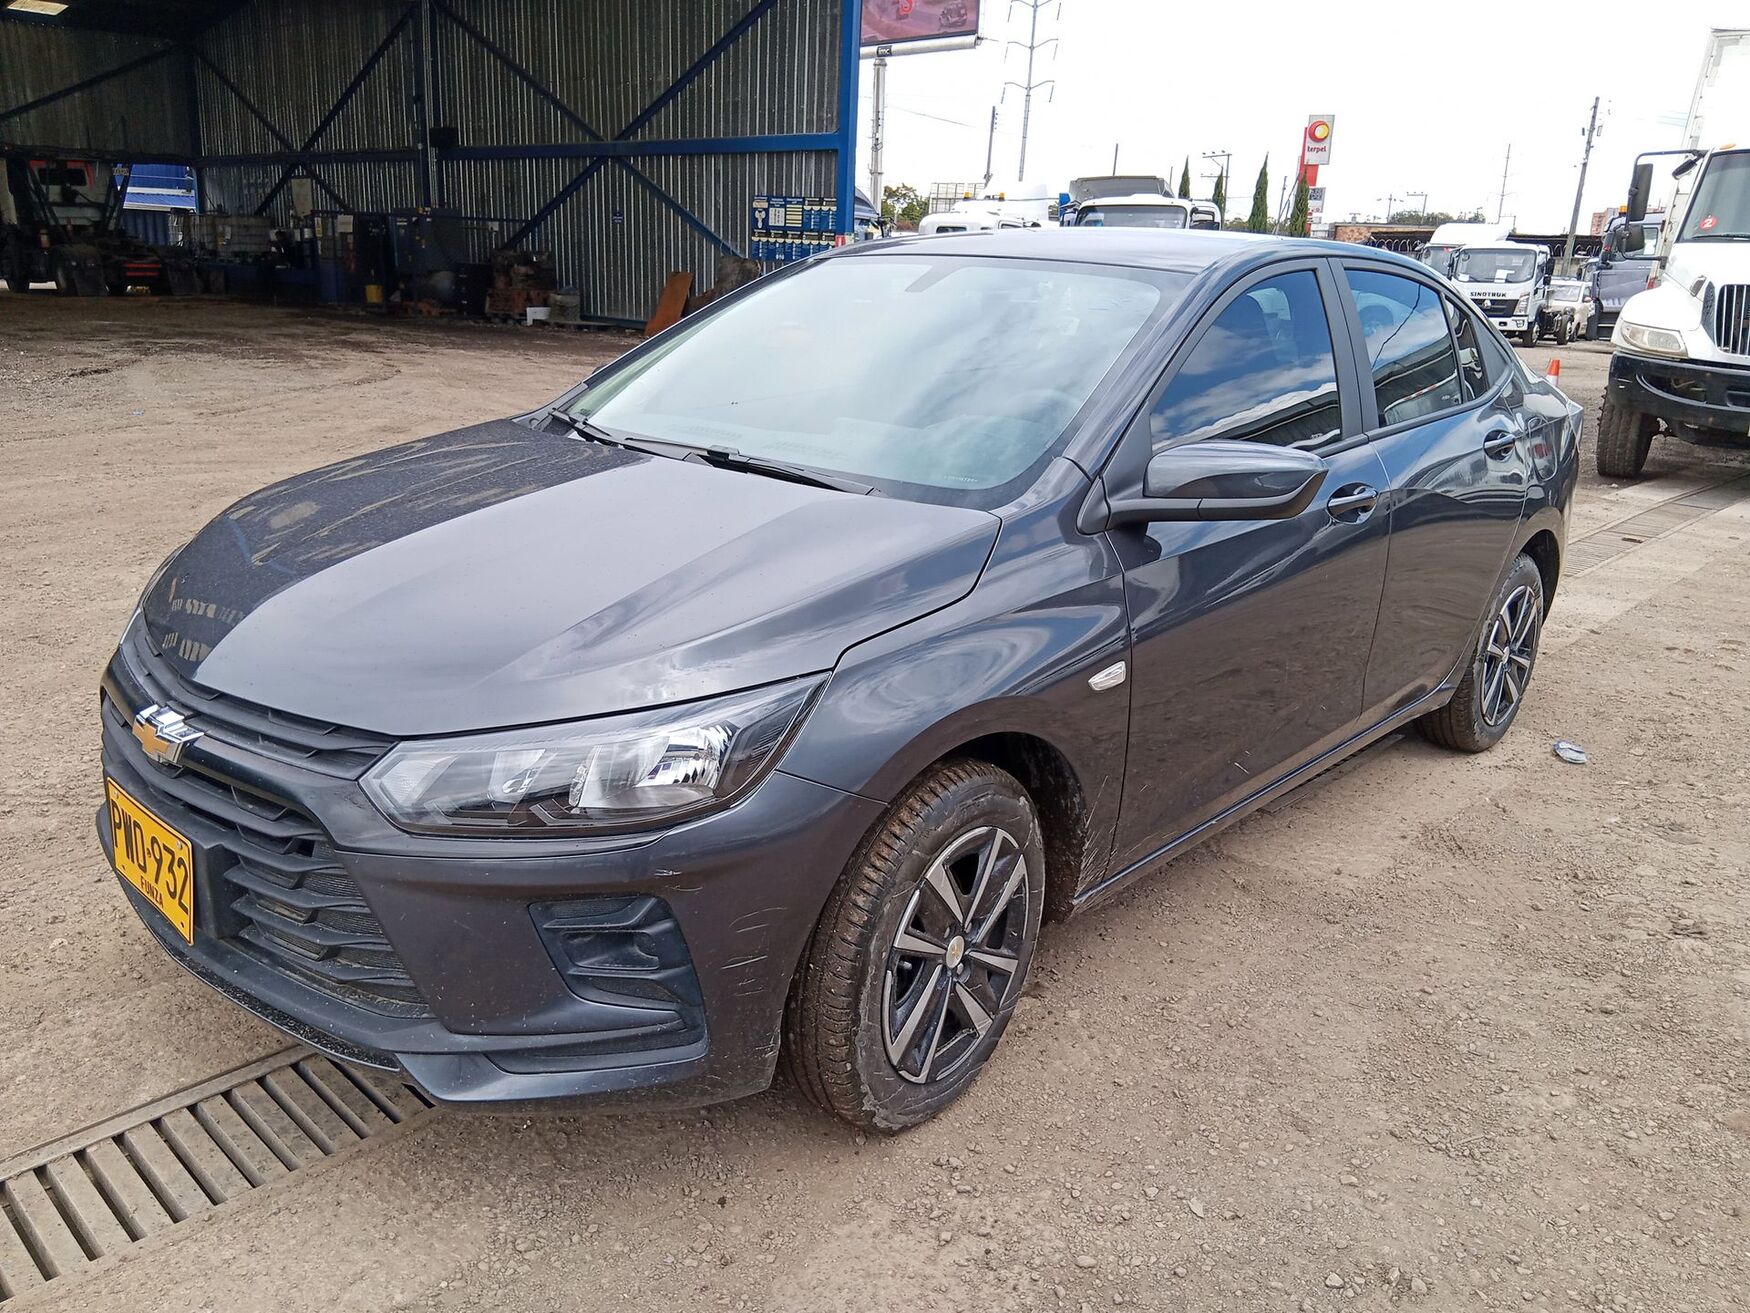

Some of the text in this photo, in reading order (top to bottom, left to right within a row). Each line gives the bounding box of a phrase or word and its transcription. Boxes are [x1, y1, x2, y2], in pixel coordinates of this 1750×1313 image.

[1307, 145, 1327, 154] terpel
[1703, 218, 1713, 228] 2
[140, 875, 164, 909] FUNZA
